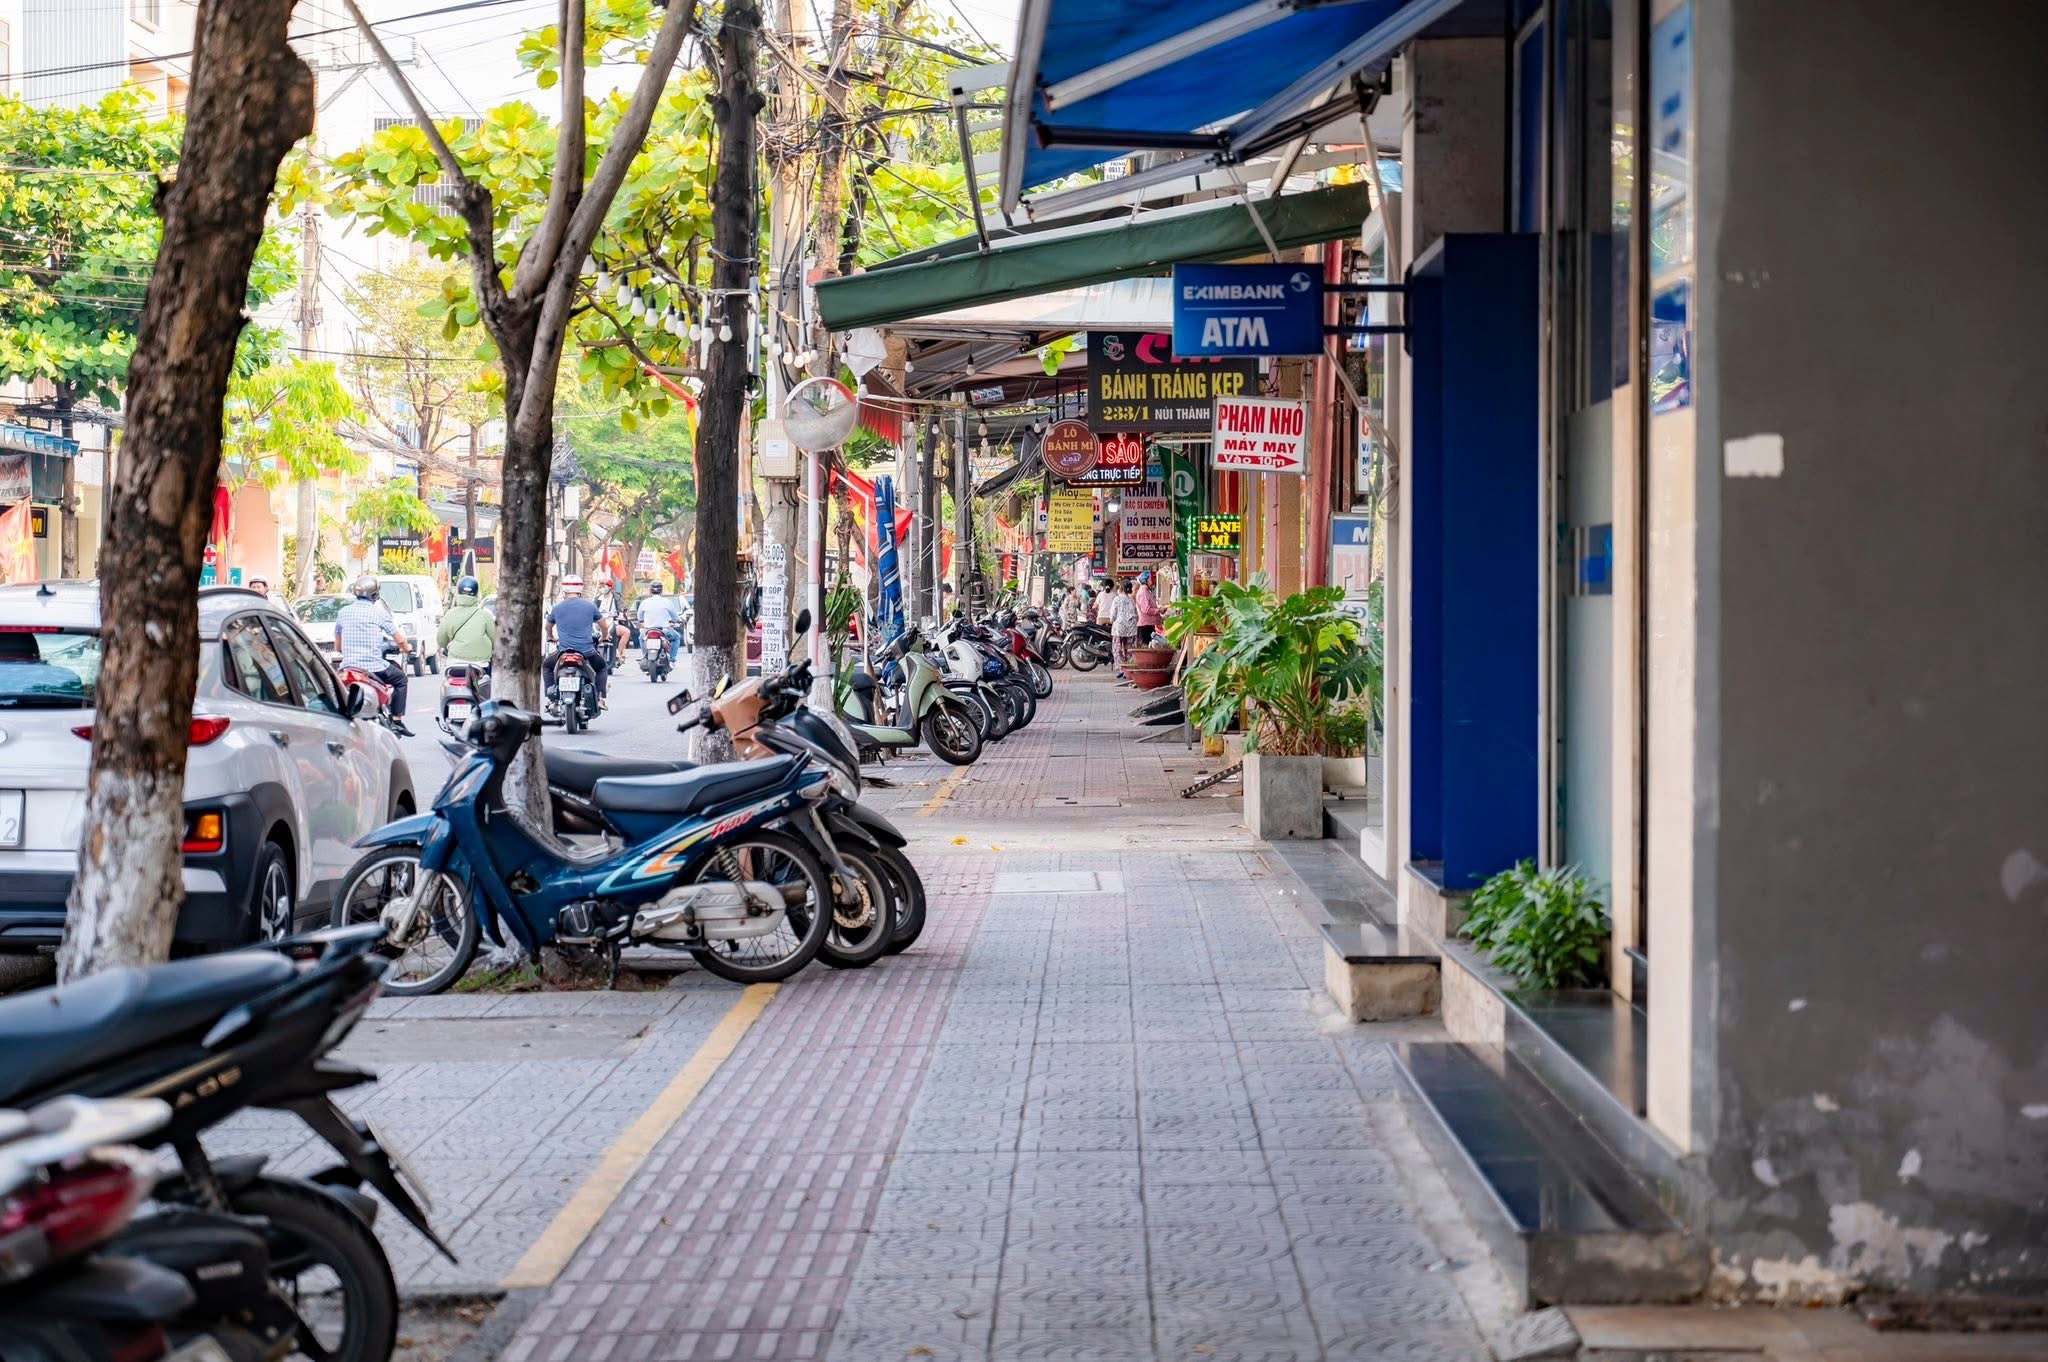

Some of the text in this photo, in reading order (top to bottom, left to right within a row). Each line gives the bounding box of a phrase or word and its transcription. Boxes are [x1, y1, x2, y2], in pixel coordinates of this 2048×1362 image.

[1183, 285, 1285, 300] EXIMBANK
[1201, 317, 1270, 347] ATM
[1101, 369, 1147, 400] BÁNH
[1152, 368, 1206, 399] TRÁNG
[1103, 406, 1210, 422] 233/1 NÚI THÀNH
[1218, 401, 1304, 436] PHẠM NHỎ
[1047, 439, 1079, 451] BÁNH
[1224, 438, 1296, 454] MÁY MAY
[1224, 455, 1286, 466] Vào 10m
[1100, 468, 1121, 481] TRỰC
[1123, 465, 1140, 479] TIẾP
[1141, 517, 1156, 529] THỊ
[1200, 519, 1241, 533] BÁNH
[1211, 532, 1230, 546] MÌ
